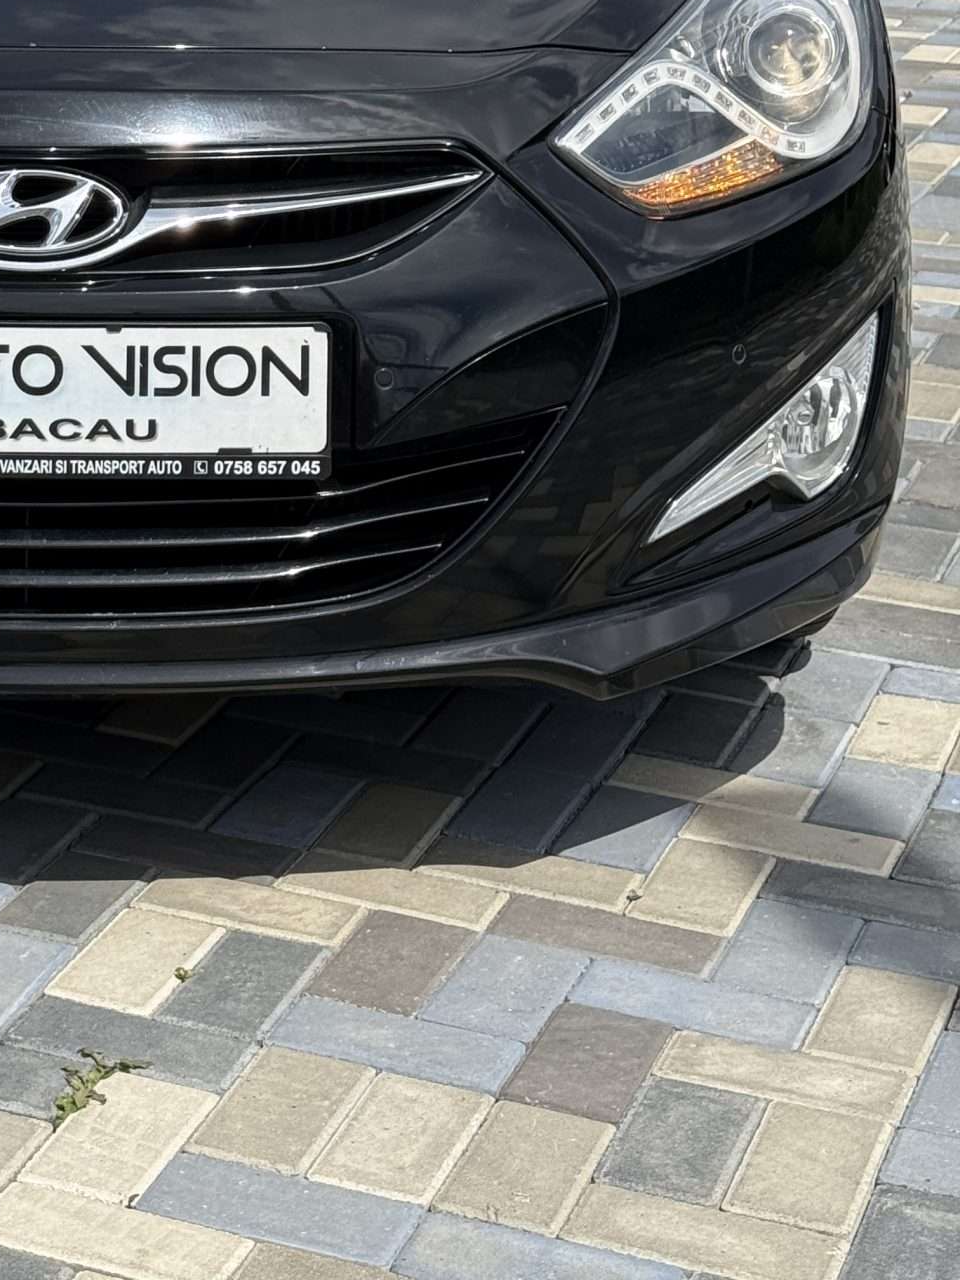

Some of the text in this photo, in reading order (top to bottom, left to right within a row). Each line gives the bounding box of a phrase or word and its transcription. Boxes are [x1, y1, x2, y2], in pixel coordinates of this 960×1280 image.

[81, 344, 310, 397] VISION
[0, 458, 53, 474] VANZARI
[55, 459, 67, 474] SI
[69, 459, 146, 475] TRANSPORT
[147, 460, 182, 475] AUTO
[213, 460, 253, 475] 0758
[257, 460, 287, 475] 657
[291, 460, 321, 475] 045
